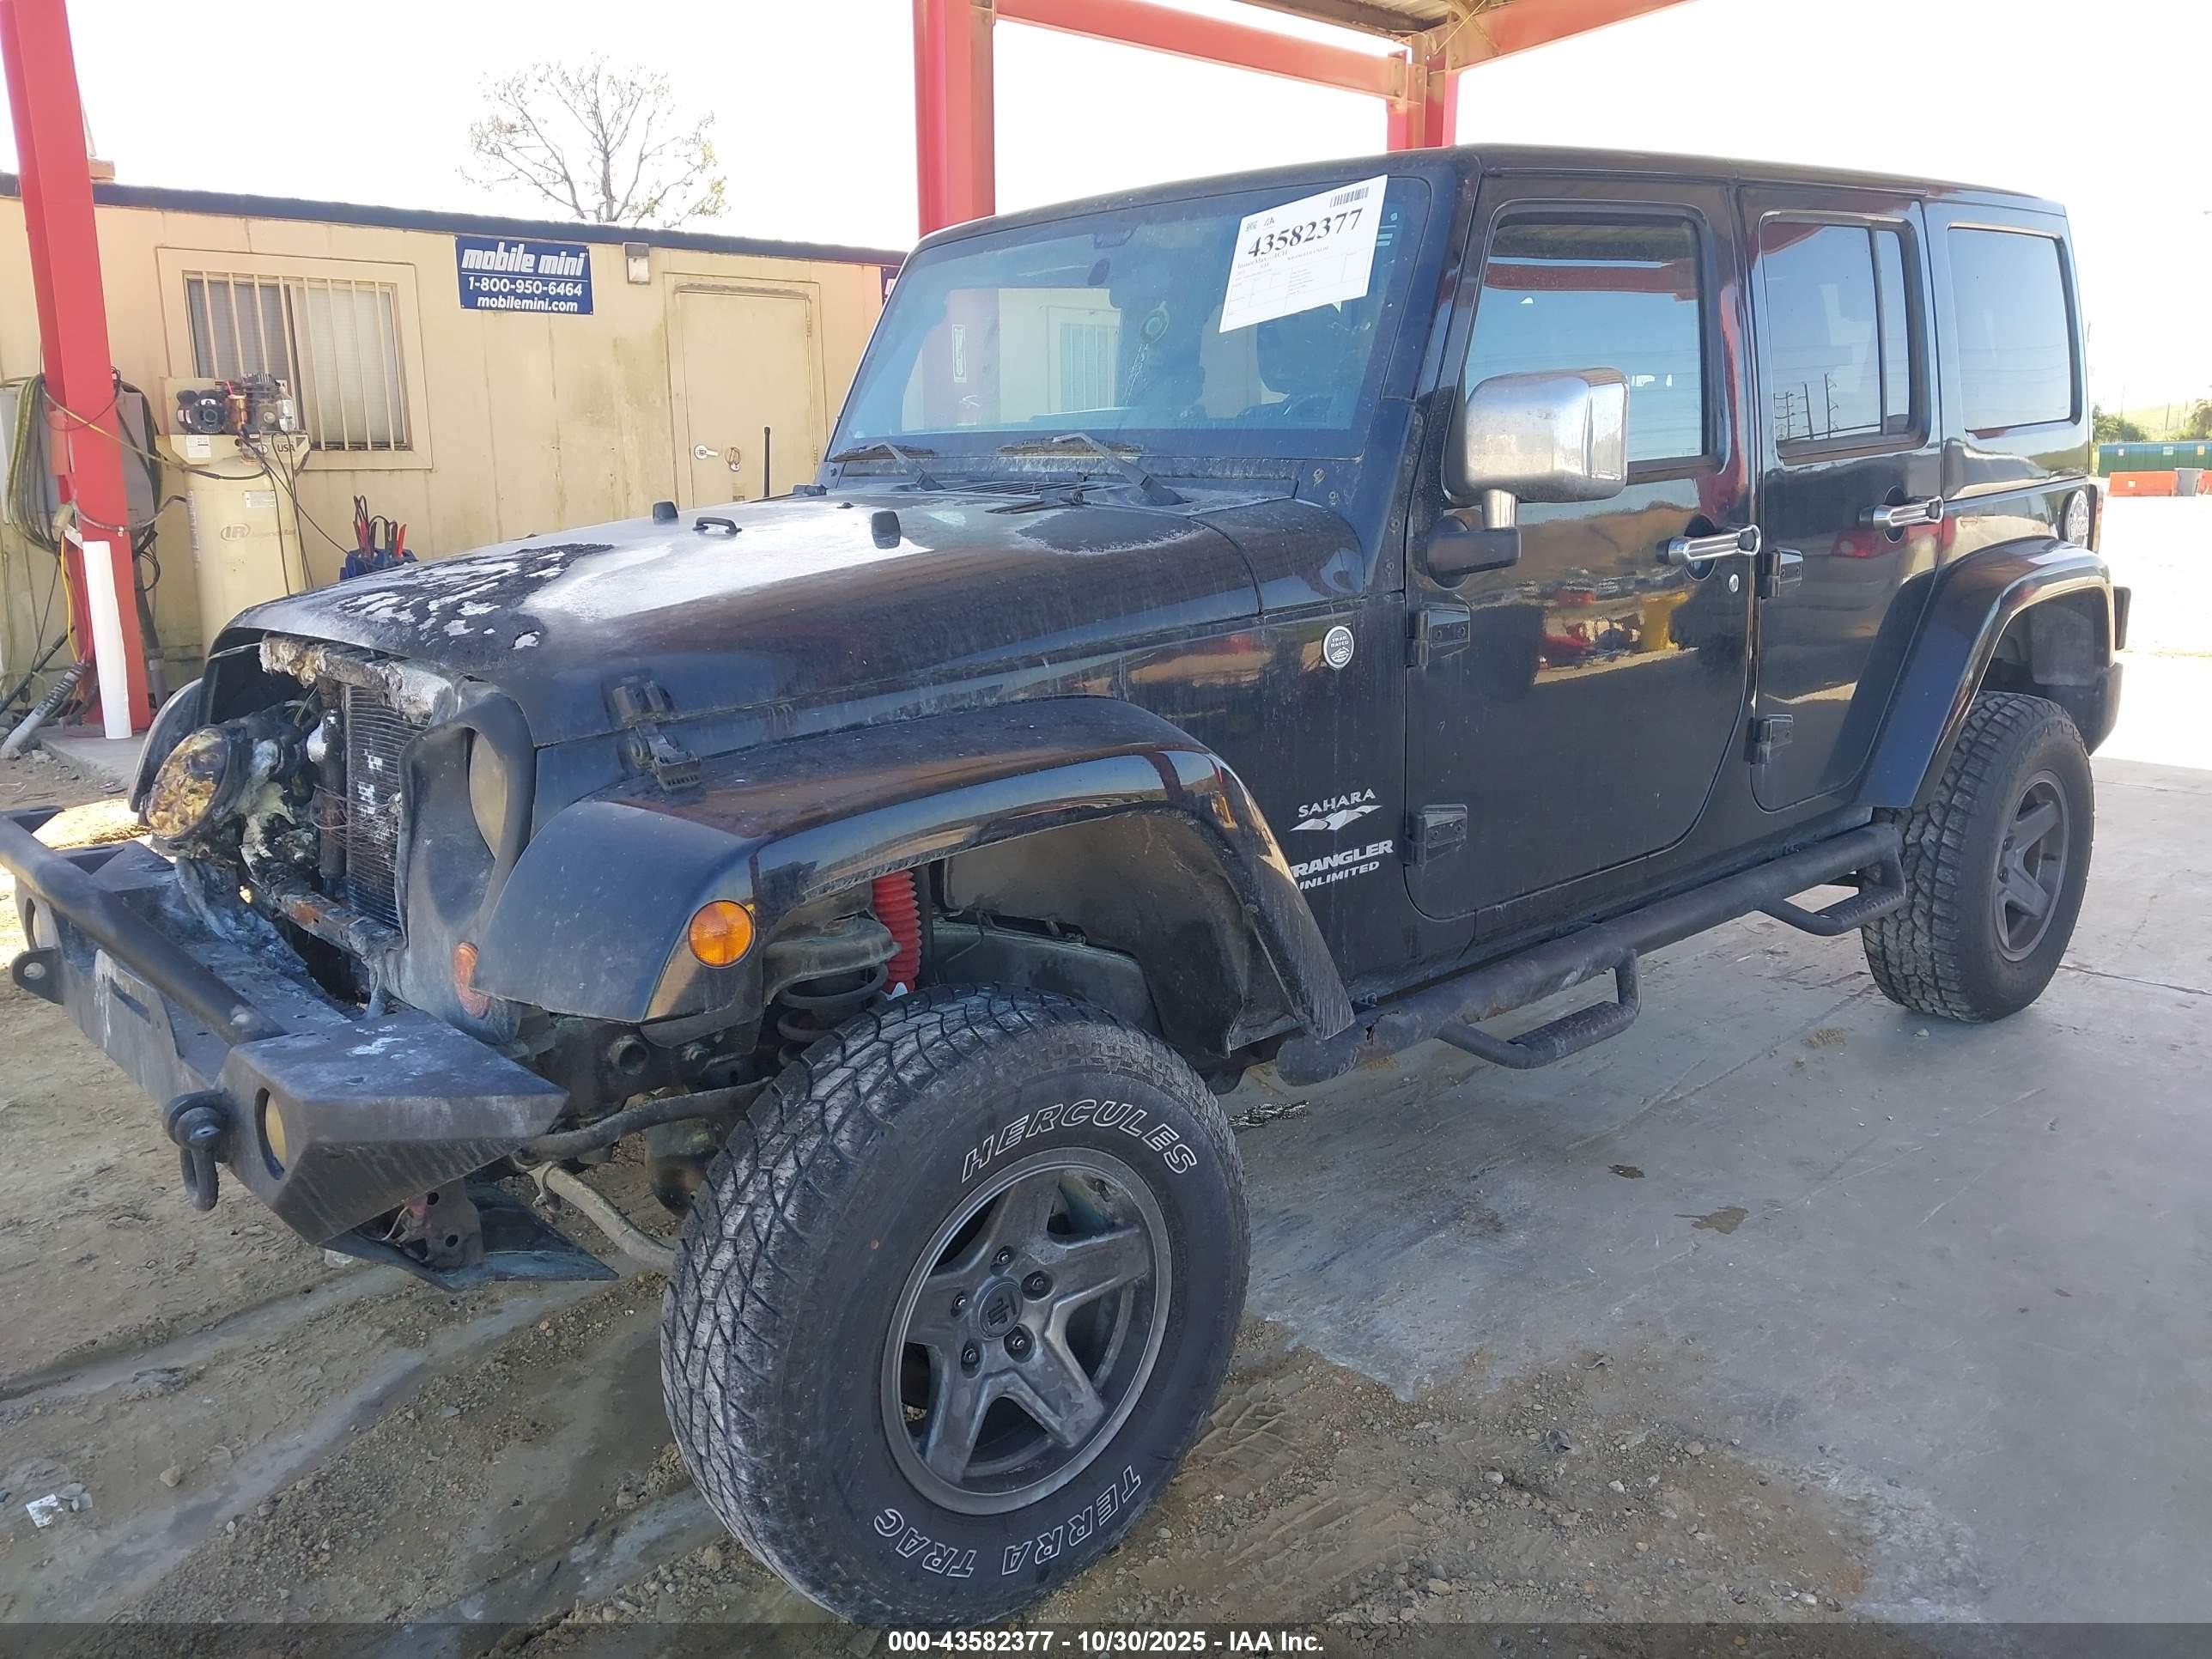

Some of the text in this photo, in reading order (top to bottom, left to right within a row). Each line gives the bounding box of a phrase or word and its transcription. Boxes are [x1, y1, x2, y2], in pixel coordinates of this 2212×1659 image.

[1248, 208, 1363, 257] 43582377
[461, 241, 586, 276] mobile mini
[468, 276, 583, 296] 1-800-950-6464
[477, 295, 578, 313] mobilemini.com
[276, 443, 296, 453] USA
[1297, 788, 1376, 817] SAHARA
[1290, 840, 1394, 878] RANGLER
[961, 1099, 1197, 1183] HERCULES
[873, 1465, 1141, 1578] TERRA TRAC
